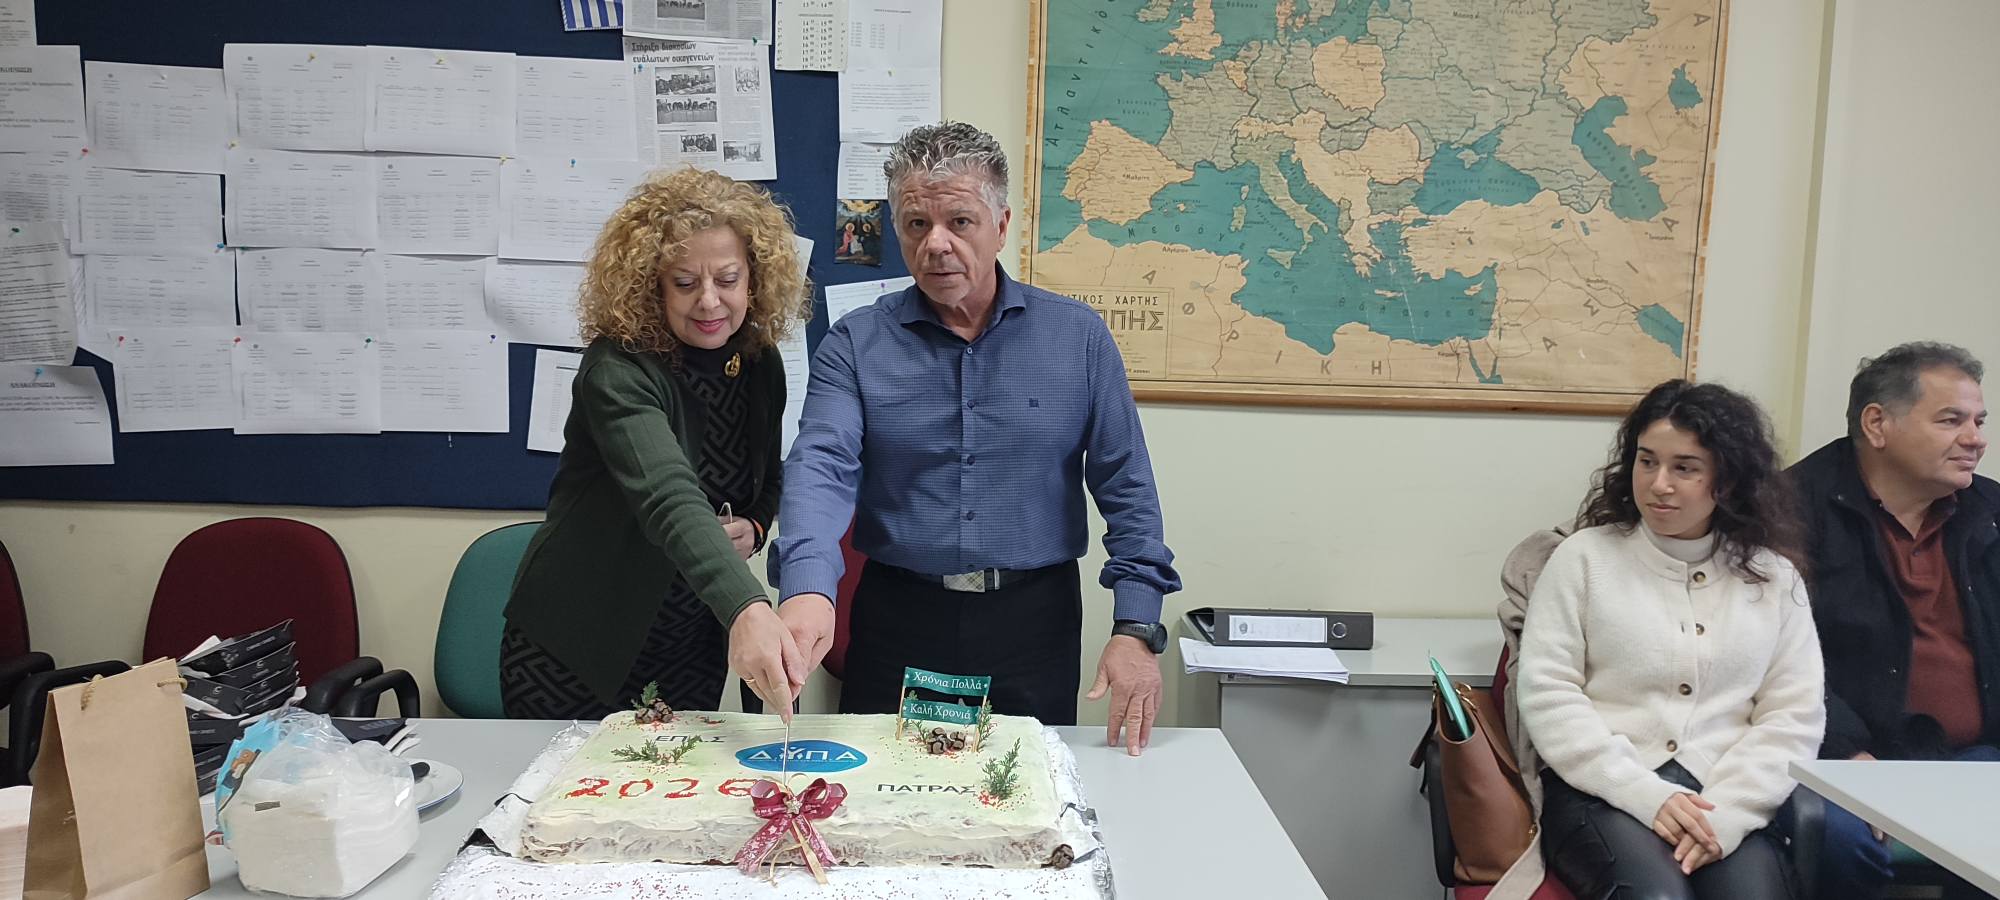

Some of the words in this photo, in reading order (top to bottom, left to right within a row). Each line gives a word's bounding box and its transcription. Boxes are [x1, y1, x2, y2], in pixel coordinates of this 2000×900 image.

[1115, 295, 1158, 306] ΧΑΡΤΗΣ
[913, 671, 950, 689] Χρόνια
[951, 678, 982, 690] Πολλά
[910, 703, 934, 717] Καλή
[935, 706, 972, 720] Χρονιά
[565, 778, 753, 799] 2026
[877, 784, 977, 795] ΠΑΤΡΑΣ
